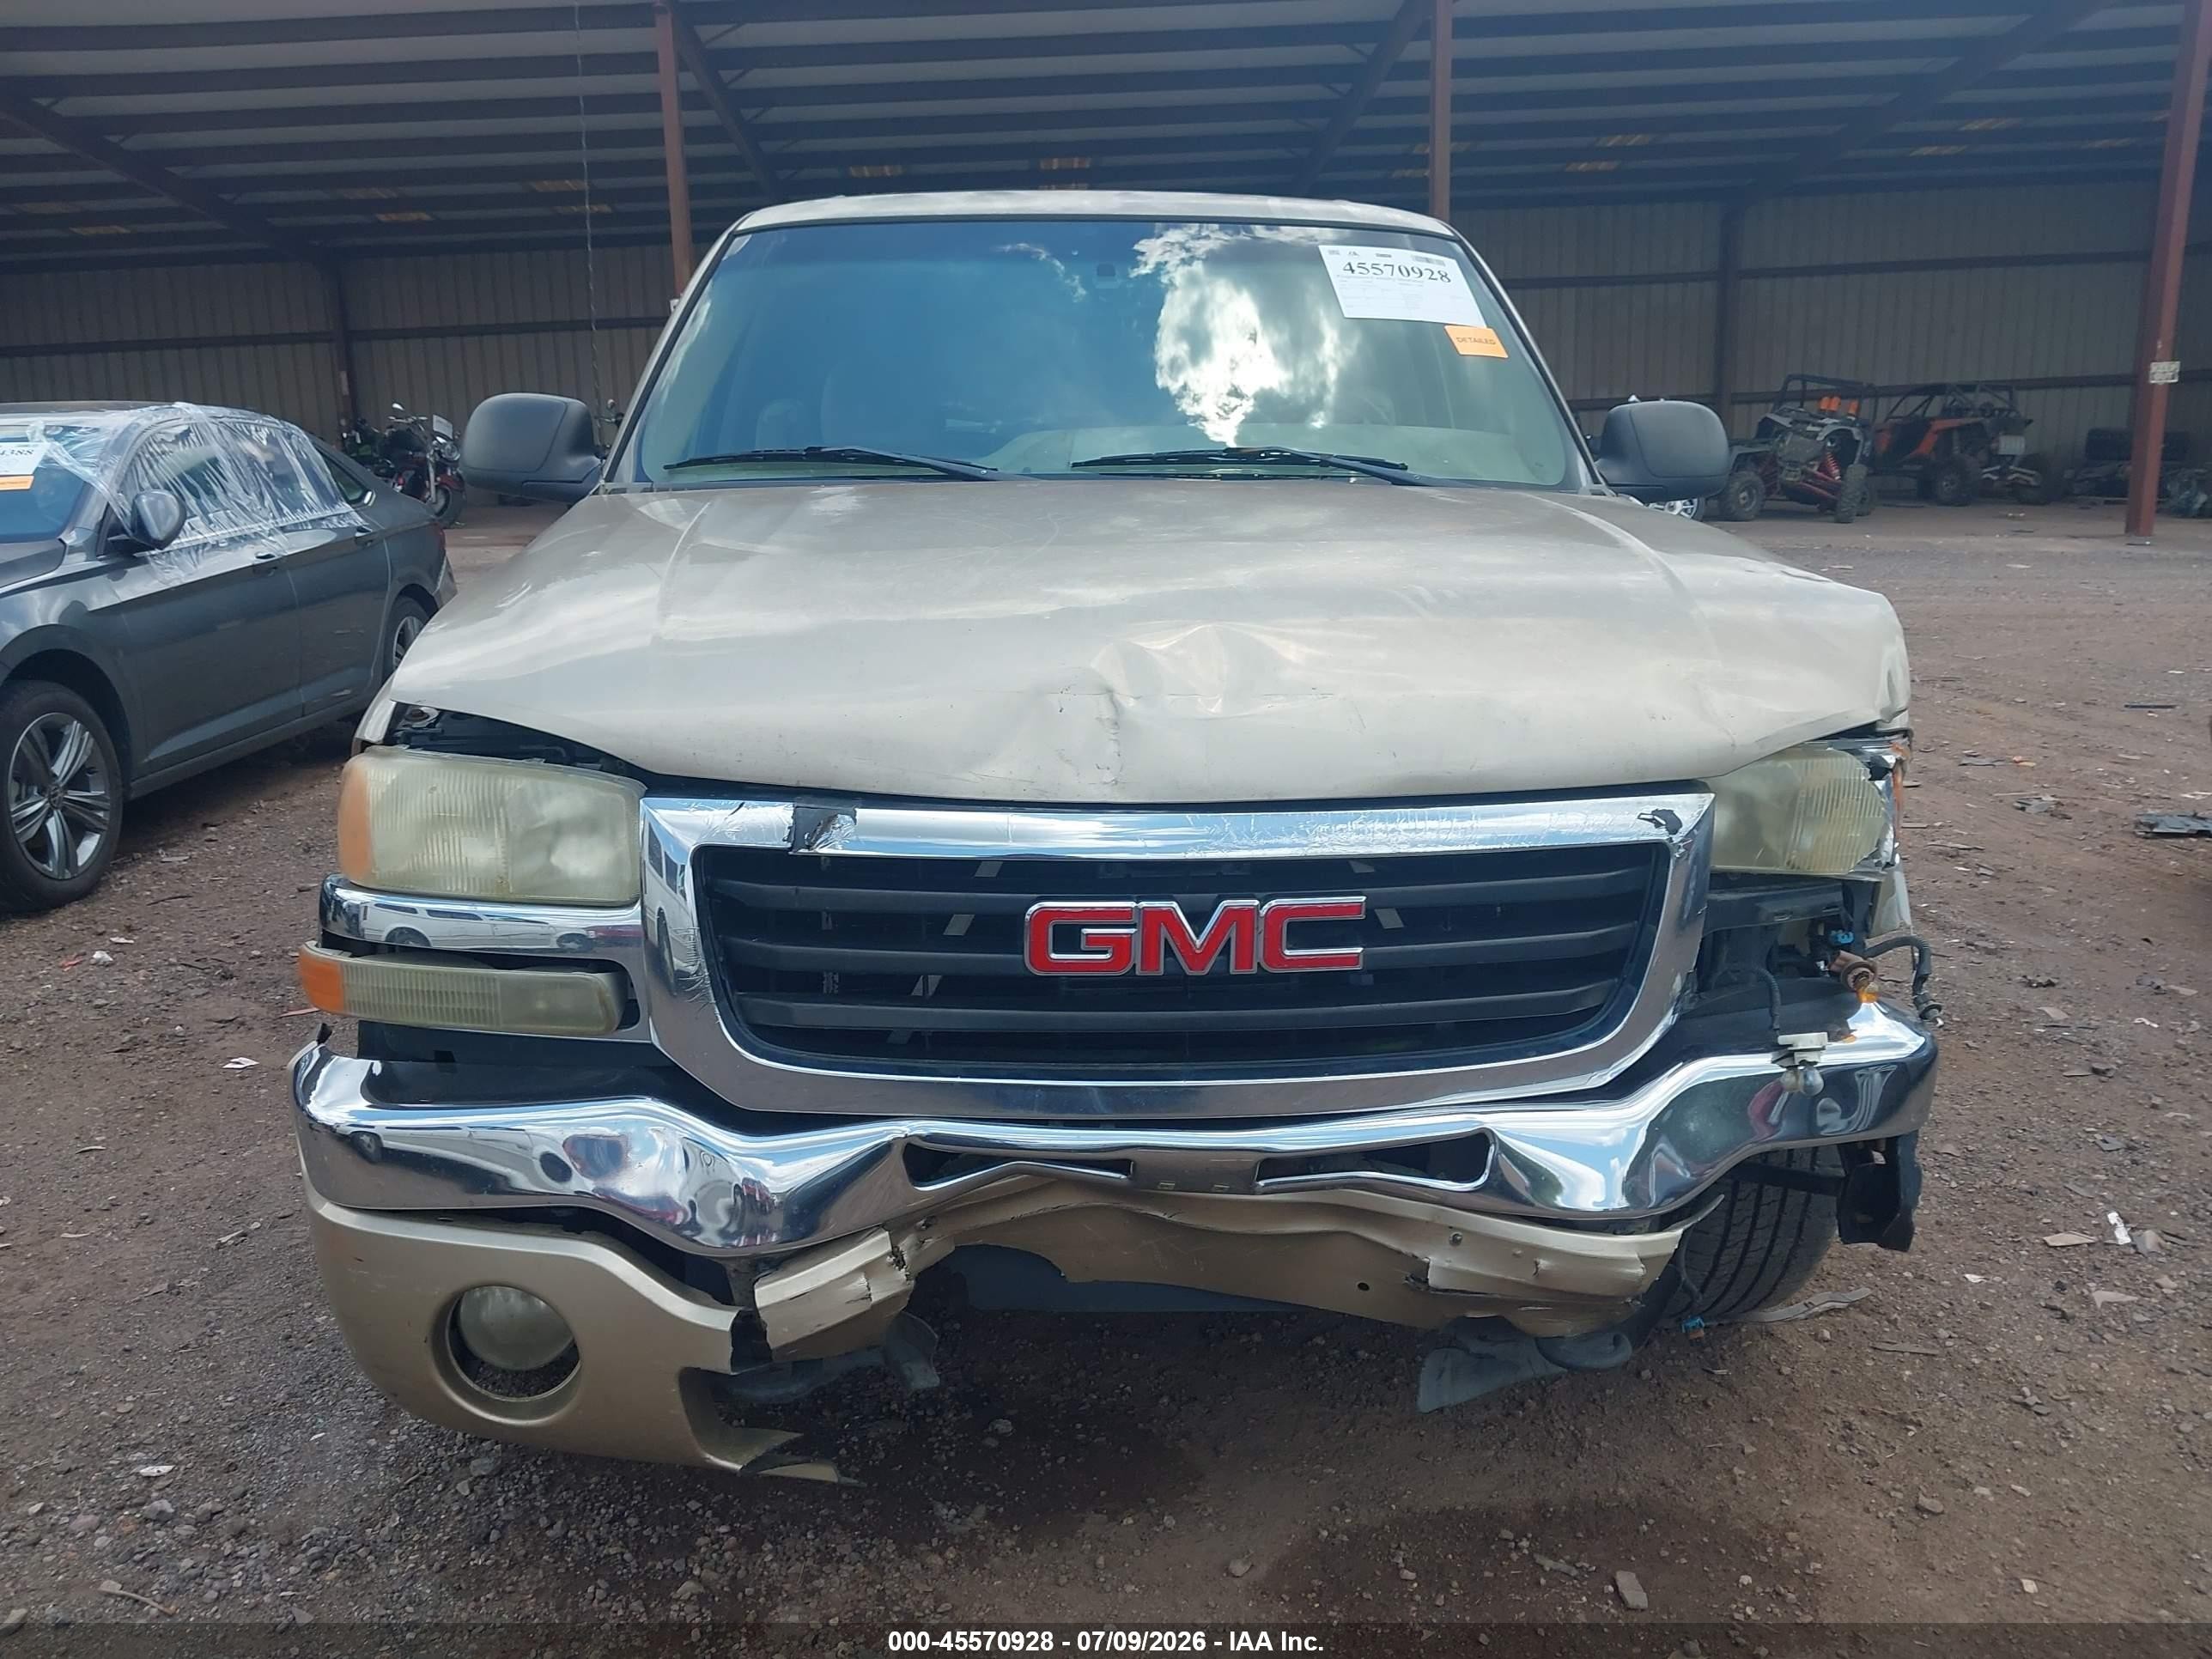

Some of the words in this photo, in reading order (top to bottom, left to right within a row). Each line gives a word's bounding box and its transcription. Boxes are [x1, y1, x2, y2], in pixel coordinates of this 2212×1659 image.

[1342, 261, 1451, 283] 45570928
[1455, 337, 1496, 346] DETAILED
[1024, 896, 1367, 975] GMC
